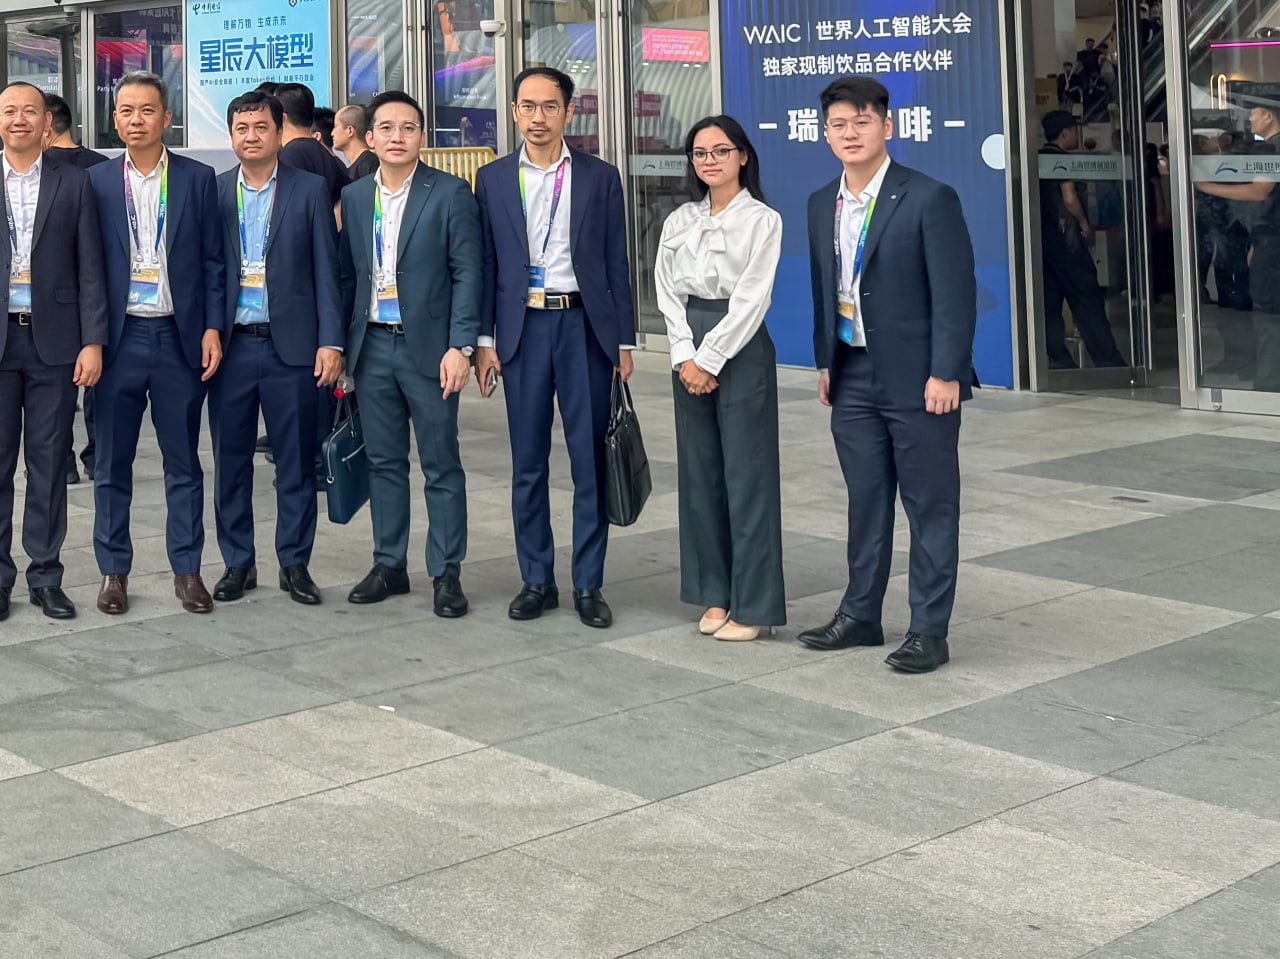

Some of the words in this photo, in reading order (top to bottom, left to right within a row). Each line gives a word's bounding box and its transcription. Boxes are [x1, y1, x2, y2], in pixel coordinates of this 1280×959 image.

[743, 22, 802, 46] WAIC
[815, 11, 972, 41] 世界人工智能大会
[199, 32, 314, 73] 星辰大模型
[762, 48, 953, 77] 独家现制饮品合作伙伴
